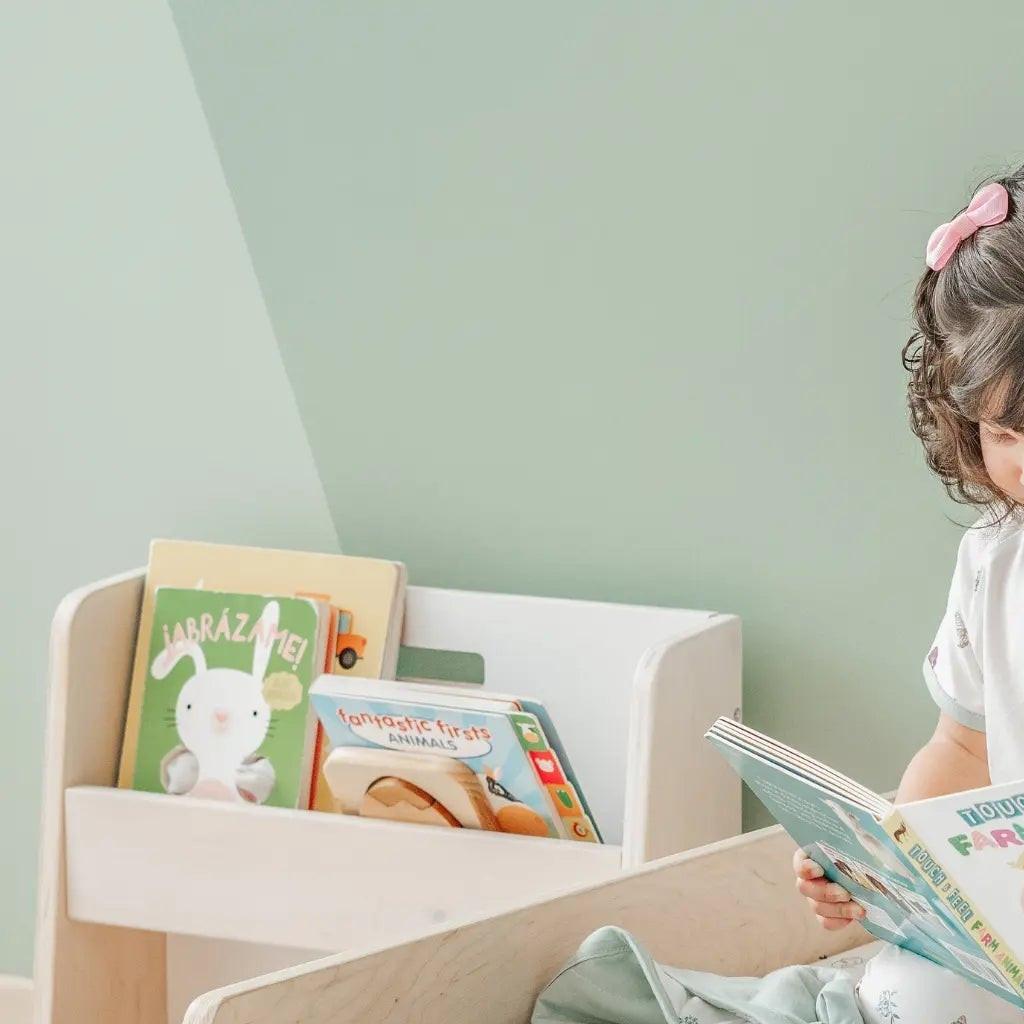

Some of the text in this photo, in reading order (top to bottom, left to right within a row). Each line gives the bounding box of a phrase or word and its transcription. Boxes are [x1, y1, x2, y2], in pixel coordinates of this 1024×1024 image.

[336, 708, 491, 741] fantastic firsts
[388, 732, 458, 751] ANIMALS
[908, 844, 947, 887] TOUCH
[946, 888, 975, 923] FEEL
[971, 920, 999, 952] FARM
